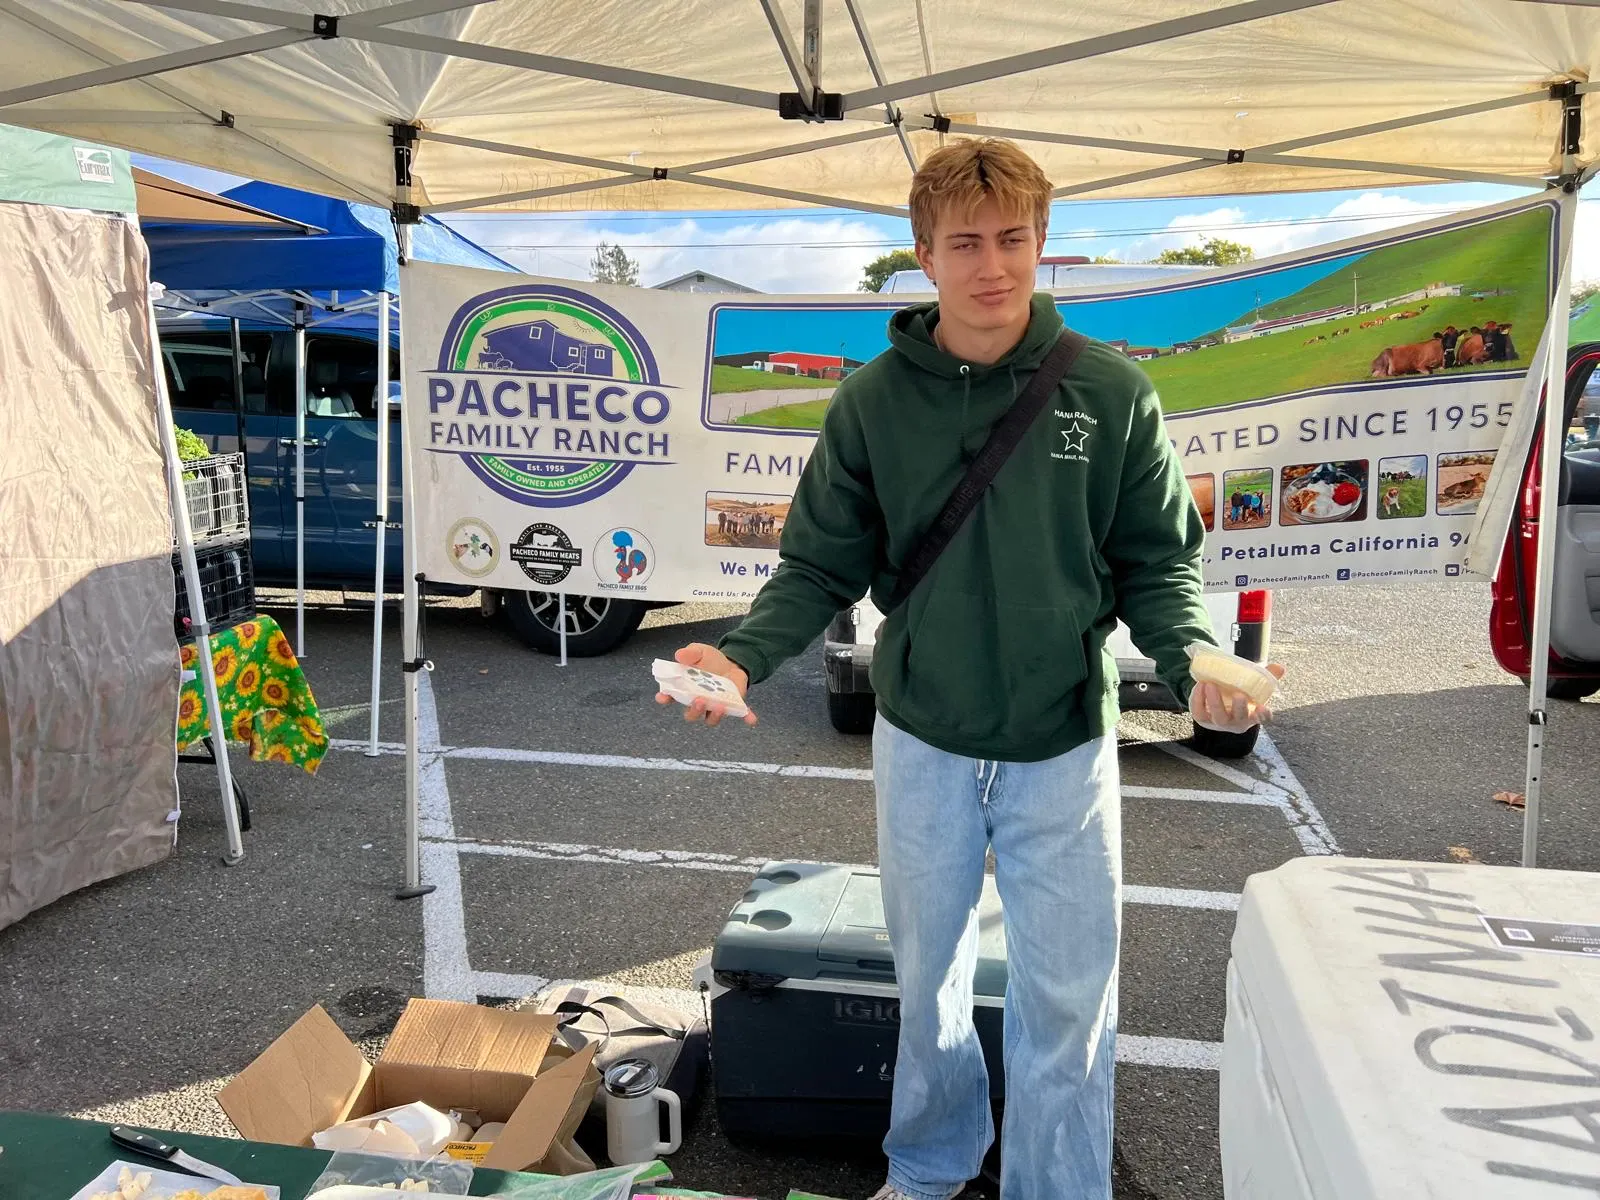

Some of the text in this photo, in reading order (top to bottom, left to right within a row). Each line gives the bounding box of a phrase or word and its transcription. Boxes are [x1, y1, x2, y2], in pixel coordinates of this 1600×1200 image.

[427, 377, 671, 425] PACHECO
[1054, 409, 1097, 425] HANA RANCH
[1299, 410, 1407, 442] SINCE
[1427, 403, 1512, 431] 1955
[430, 422, 669, 457] FAMILY RANCH
[489, 458, 606, 488] FAMILY OWNED AND OPERATED
[526, 463, 565, 473] Est. 1955
[512, 548, 580, 560] PACHECO FAMILY MEATS
[1221, 543, 1321, 561] Petaluma
[1329, 533, 1439, 553] California
[720, 561, 747, 576] We
[1249, 573, 1330, 585] /PachecoFamilyRanch
[1350, 568, 1438, 578] @PachecoFamilyRanch
[692, 589, 724, 597] Contact
